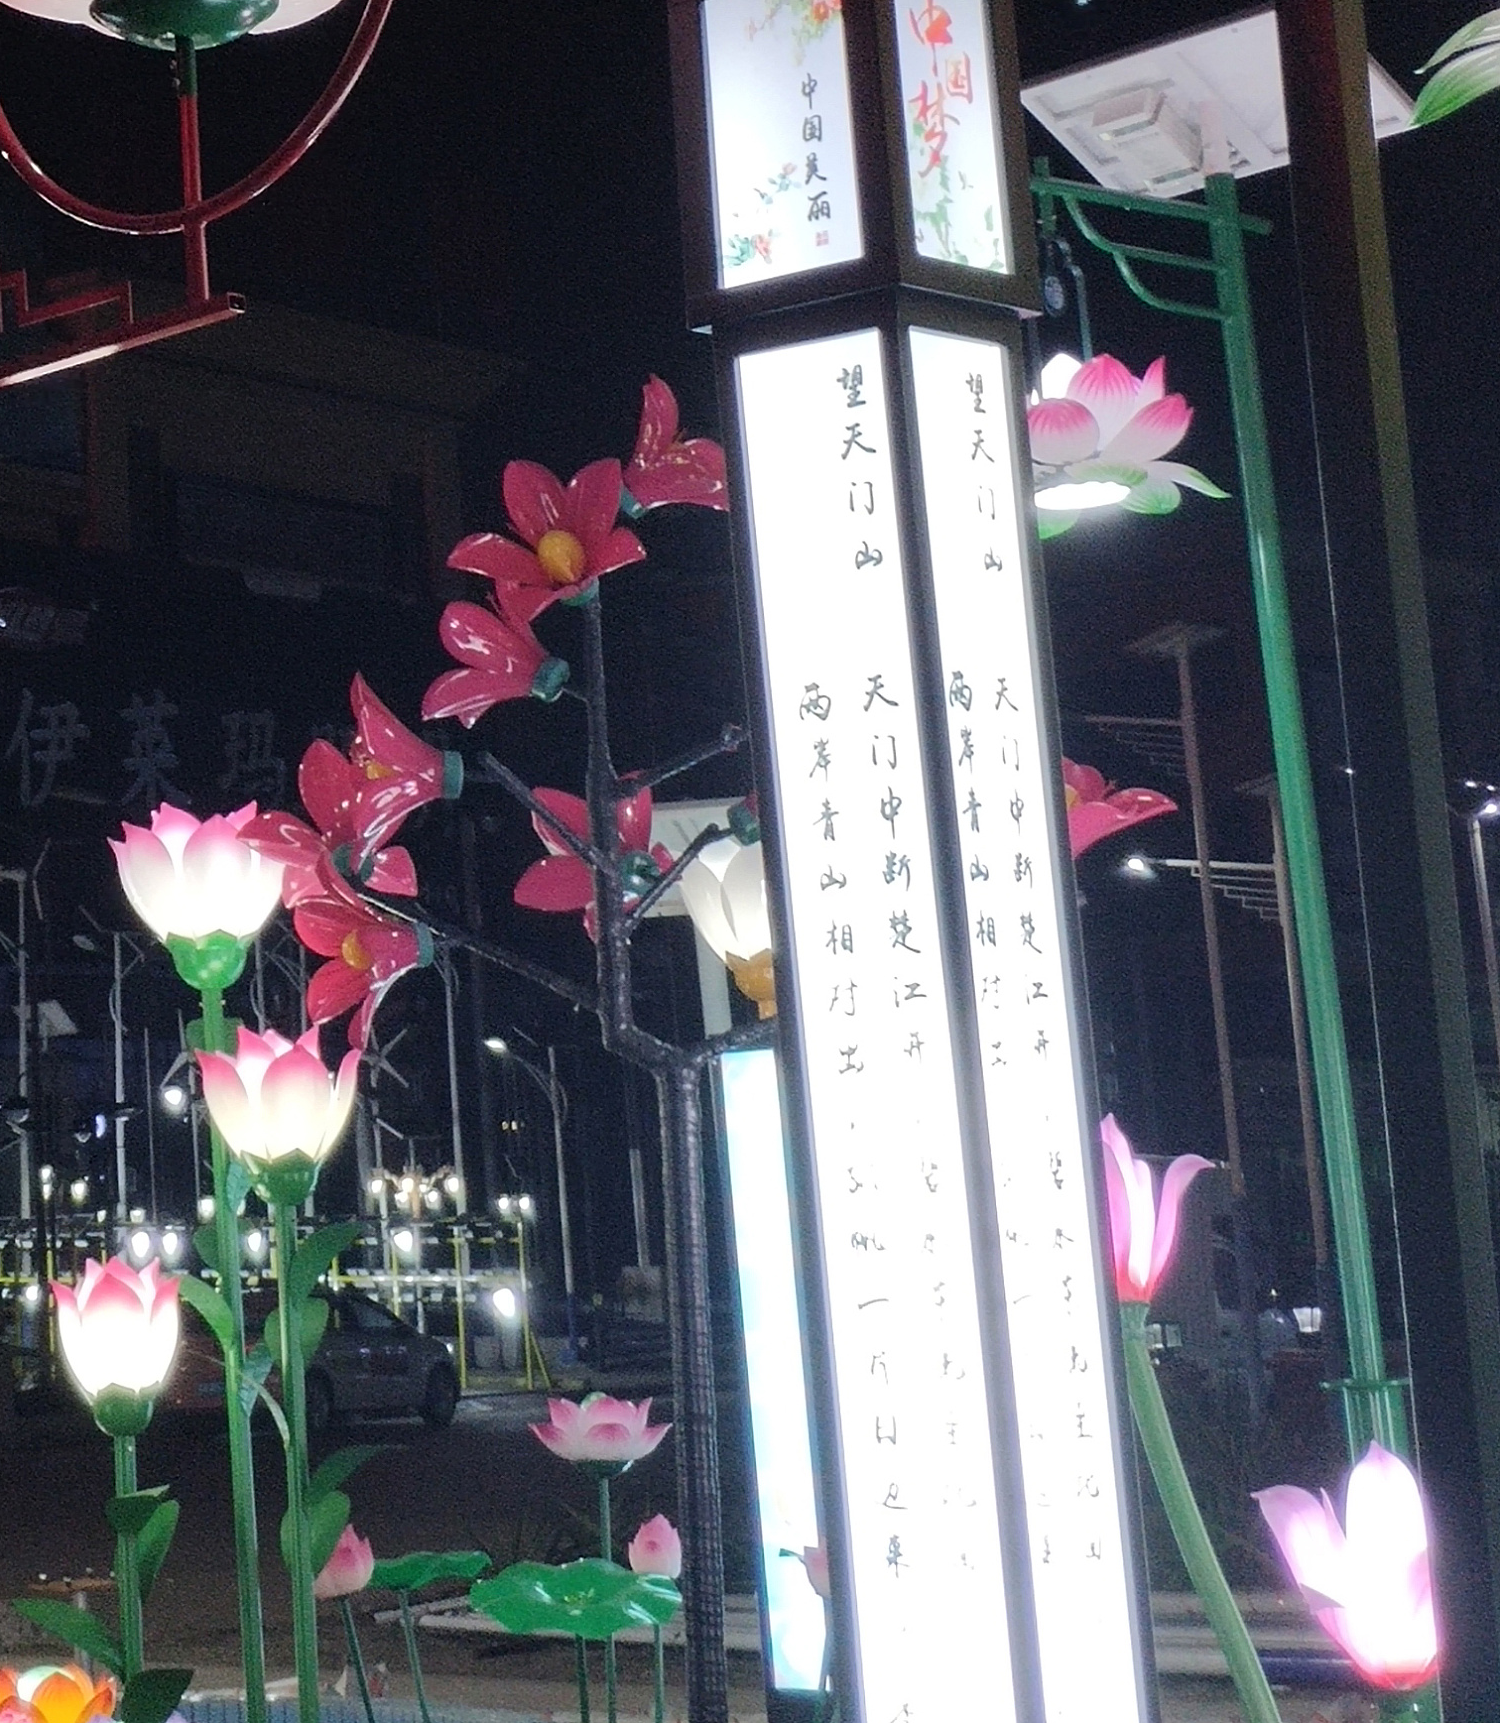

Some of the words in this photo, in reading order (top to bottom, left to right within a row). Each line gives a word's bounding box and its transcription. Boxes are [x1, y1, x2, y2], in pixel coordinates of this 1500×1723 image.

[801, 72, 832, 223] 中国美丽
[836, 364, 884, 570] 望天门山
[965, 372, 1003, 572] 望天门山
